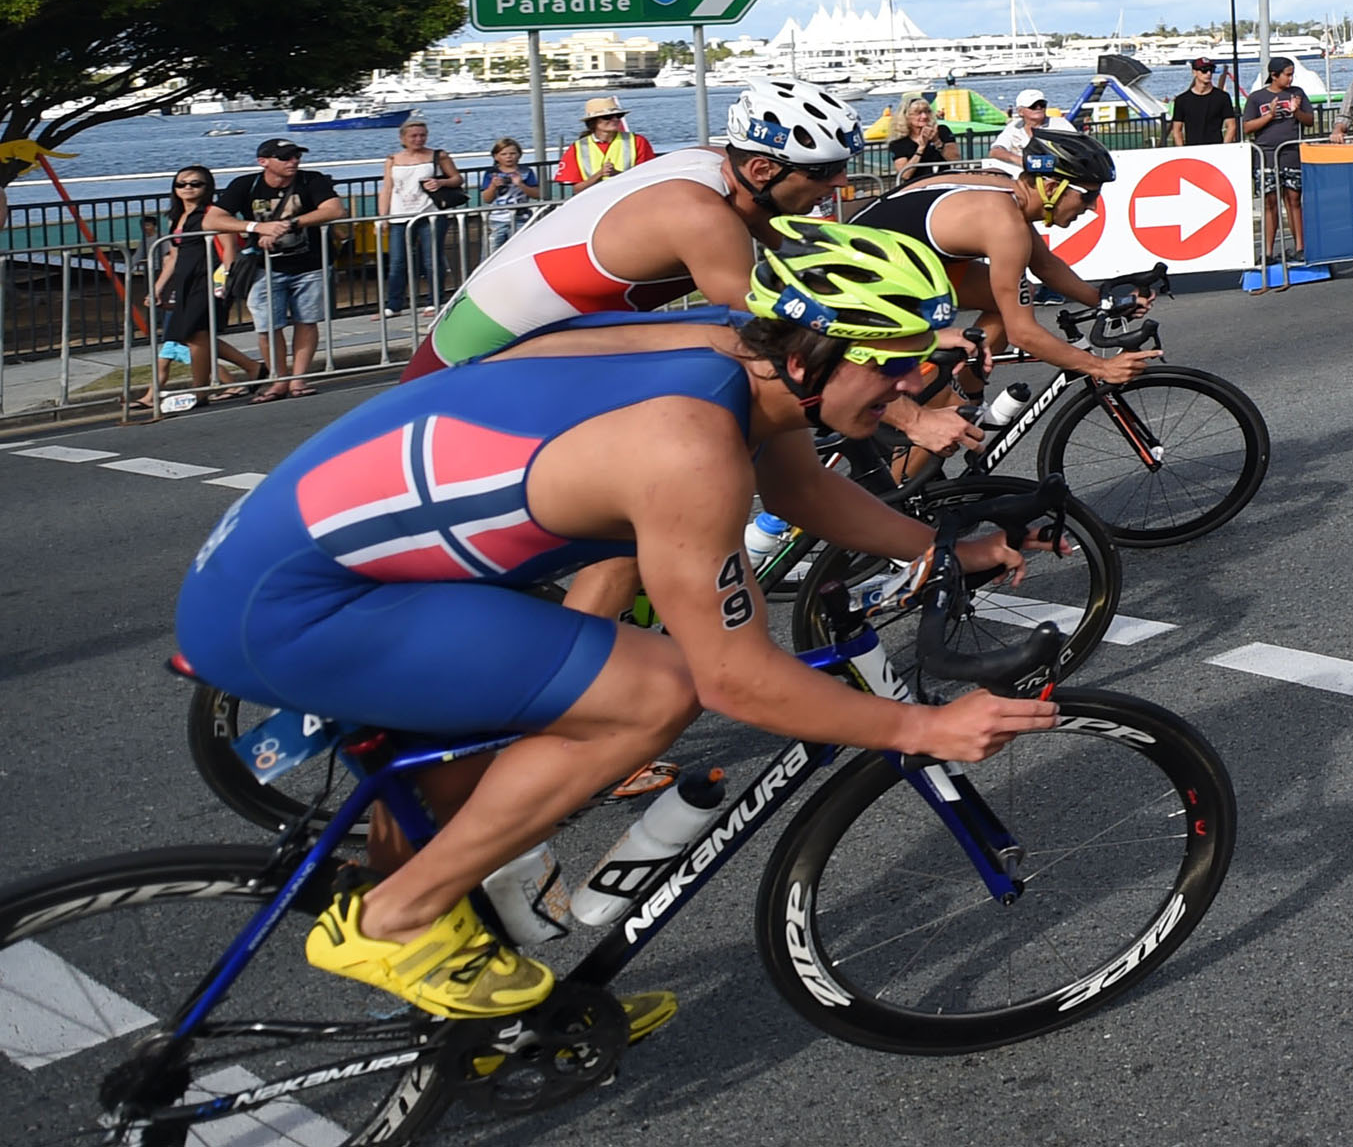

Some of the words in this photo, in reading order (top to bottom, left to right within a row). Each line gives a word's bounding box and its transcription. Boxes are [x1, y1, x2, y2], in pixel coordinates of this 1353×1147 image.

[753, 125, 769, 140] 51
[783, 298, 806, 319] 49
[830, 327, 902, 339] RUDY
[932, 302, 950, 321] 49
[986, 372, 1067, 469] MERIDA
[716, 551, 756, 631] 49
[785, 881, 854, 1008] ZIPP
[1058, 893, 1186, 1012] ZIPP
